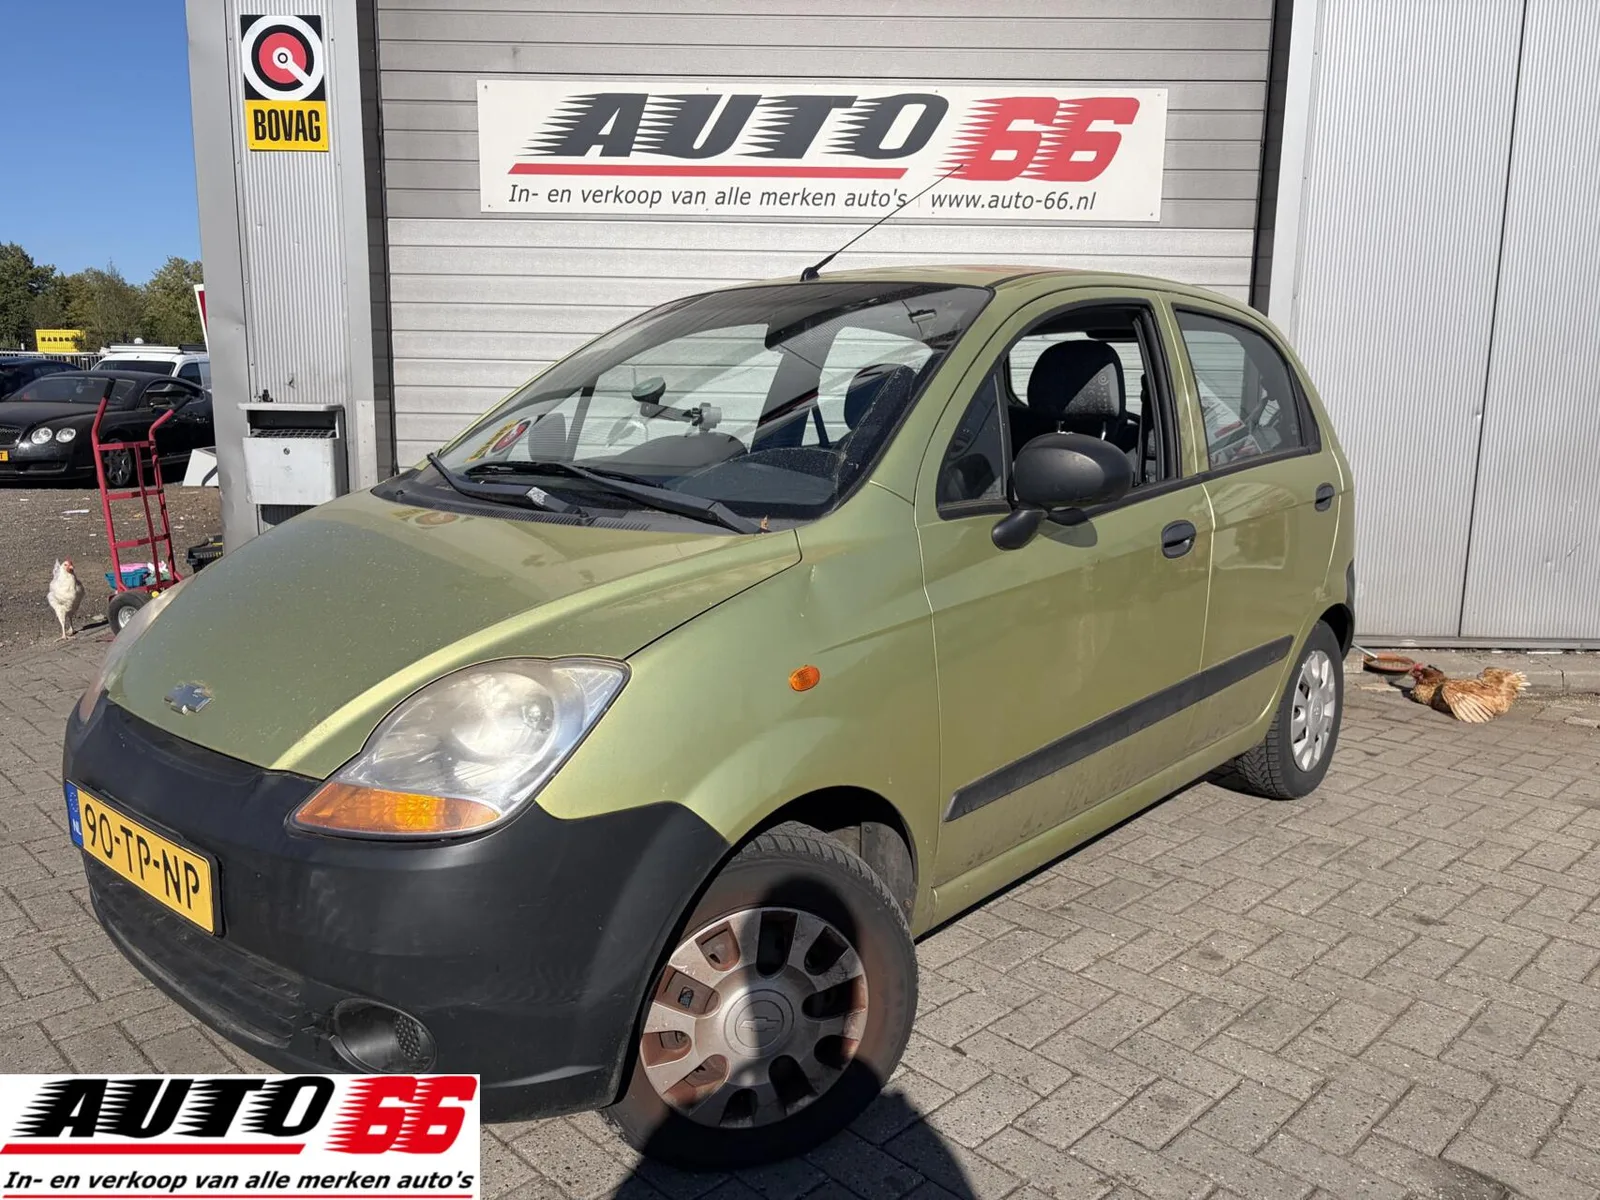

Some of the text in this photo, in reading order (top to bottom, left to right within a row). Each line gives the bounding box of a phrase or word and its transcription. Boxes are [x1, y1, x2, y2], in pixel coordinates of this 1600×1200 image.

[252, 108, 322, 143] BOVAG
[514, 92, 1141, 182] AUTO 66
[508, 184, 1098, 212] In- en verkoop van alle merken auto's www.auto-66.nl
[72, 818, 82, 836] NL
[84, 803, 200, 910] 90-TP-NP
